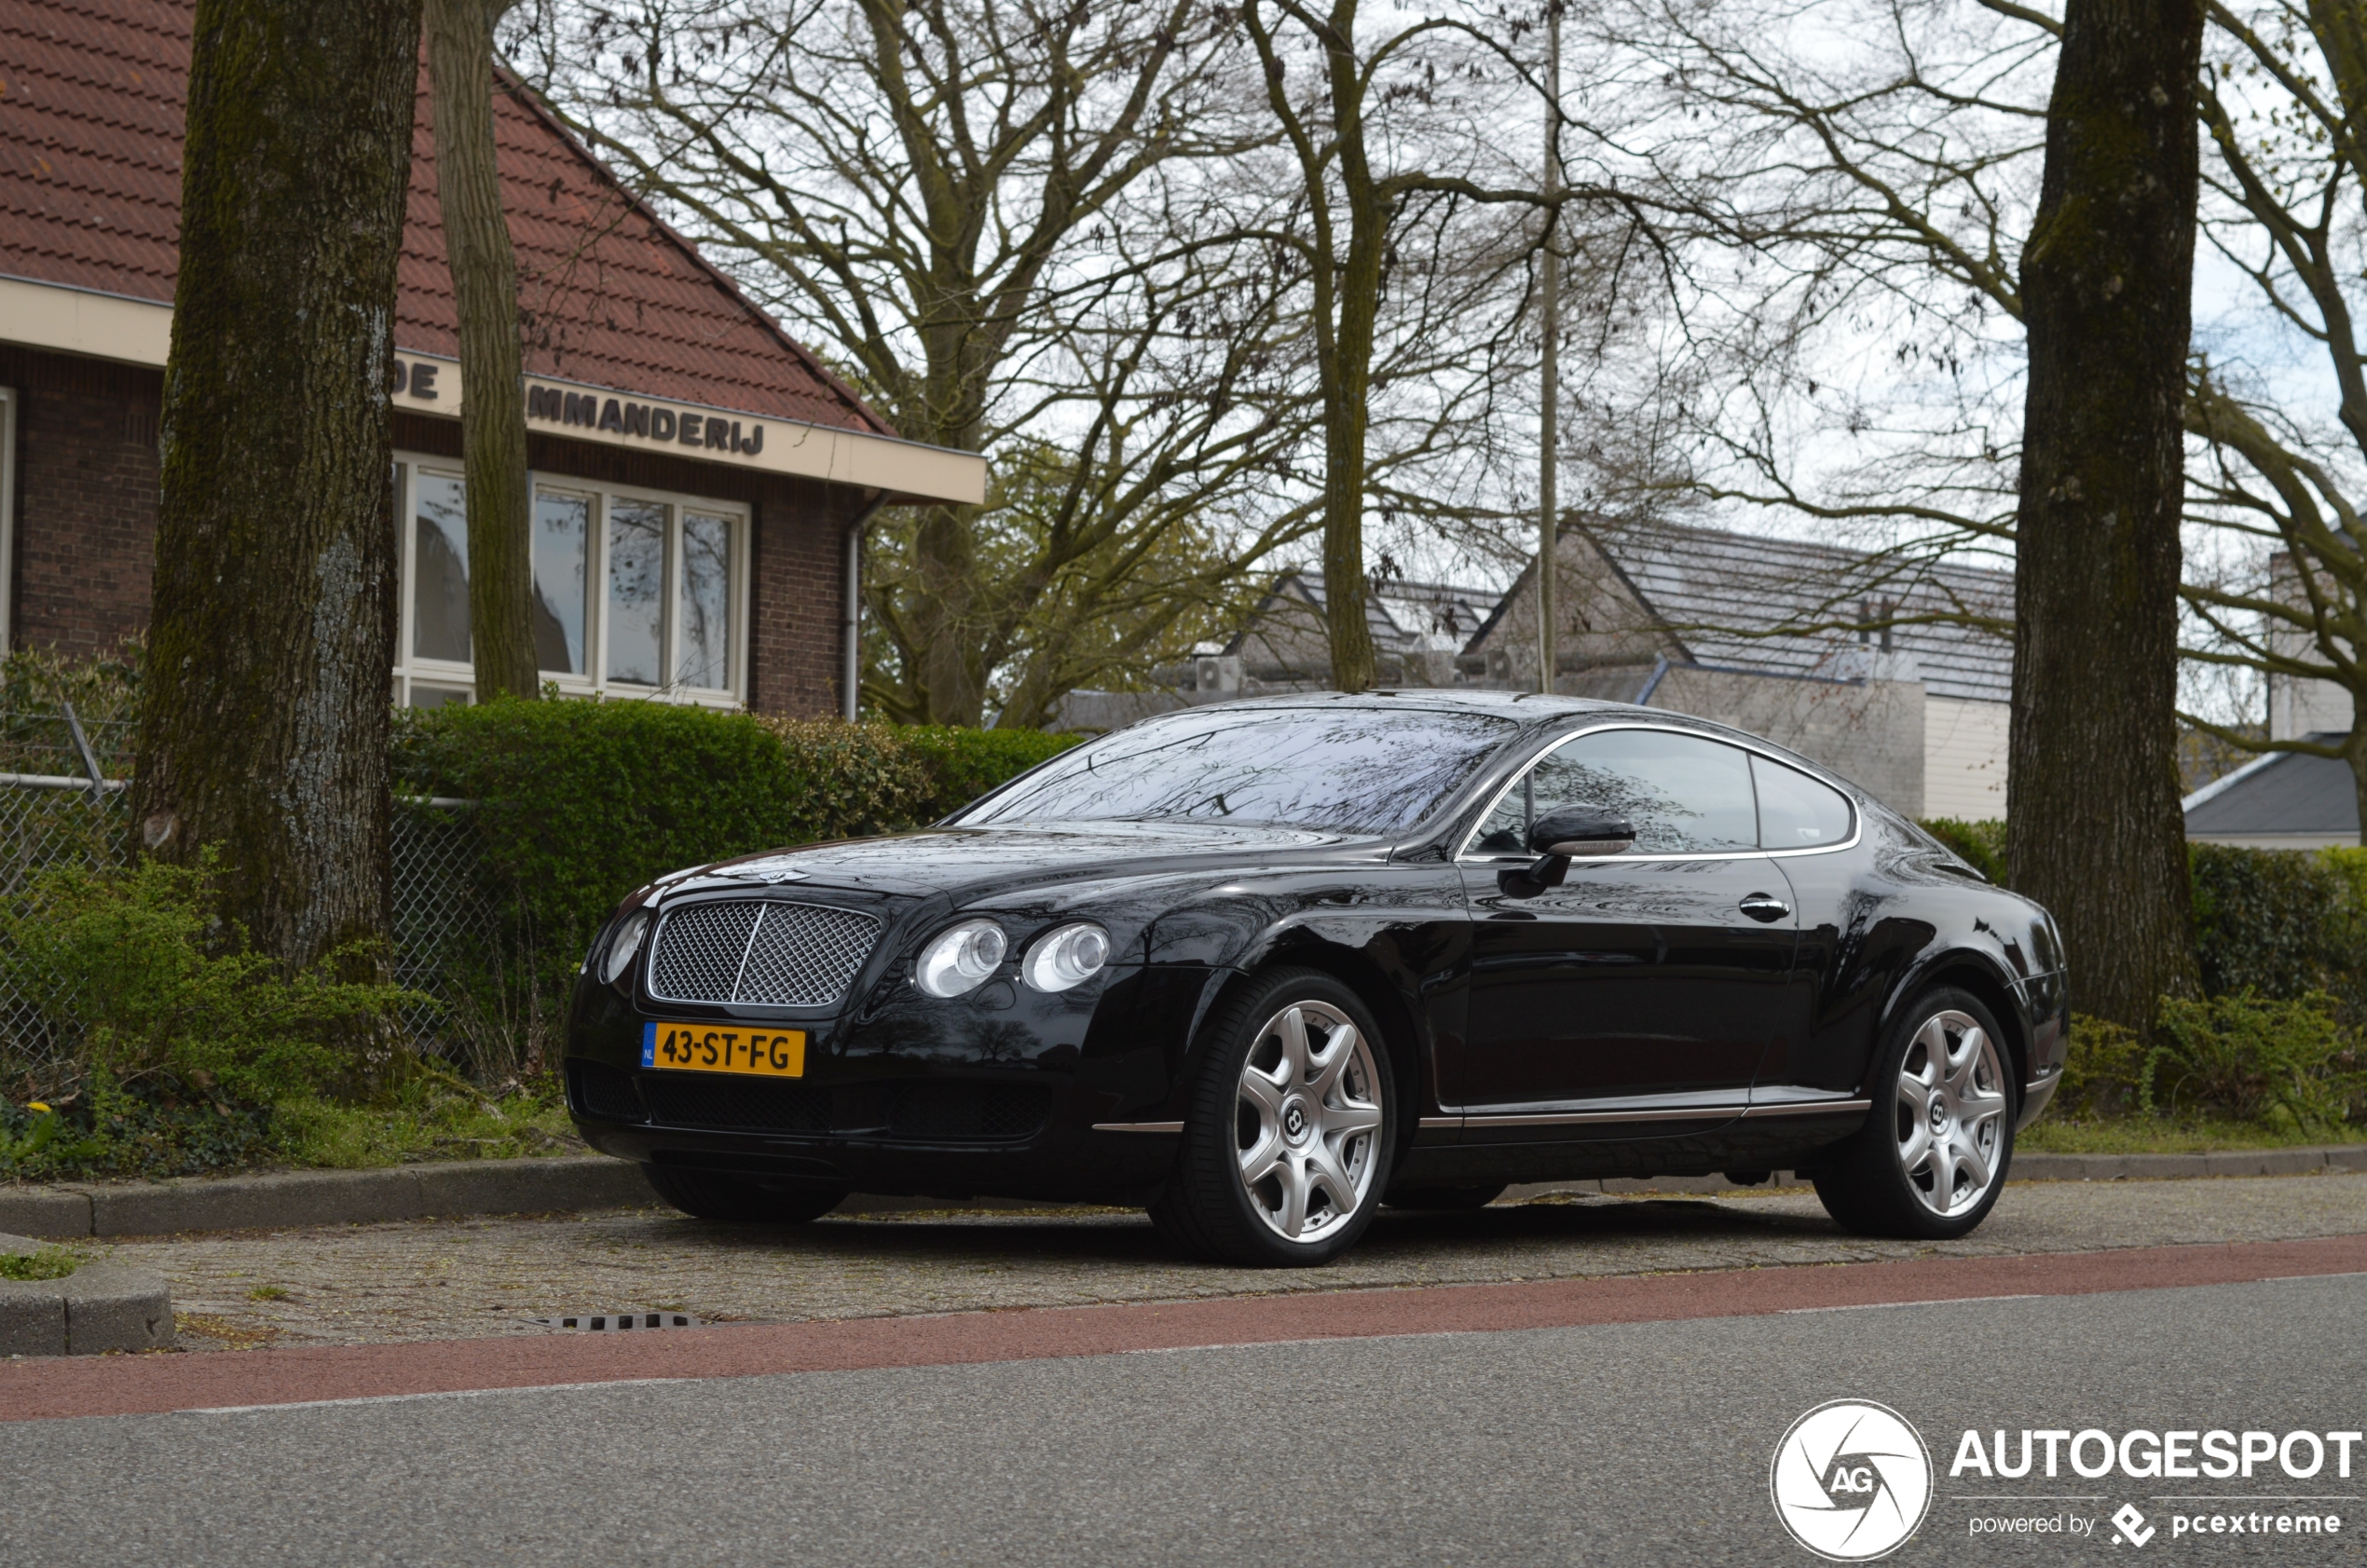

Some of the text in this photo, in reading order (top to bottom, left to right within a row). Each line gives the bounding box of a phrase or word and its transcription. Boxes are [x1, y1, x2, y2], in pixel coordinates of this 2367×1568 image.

[524, 385, 764, 456] MMANDERIJ
[644, 1049, 653, 1060] NL
[662, 1029, 788, 1070] 43-ST-FG
